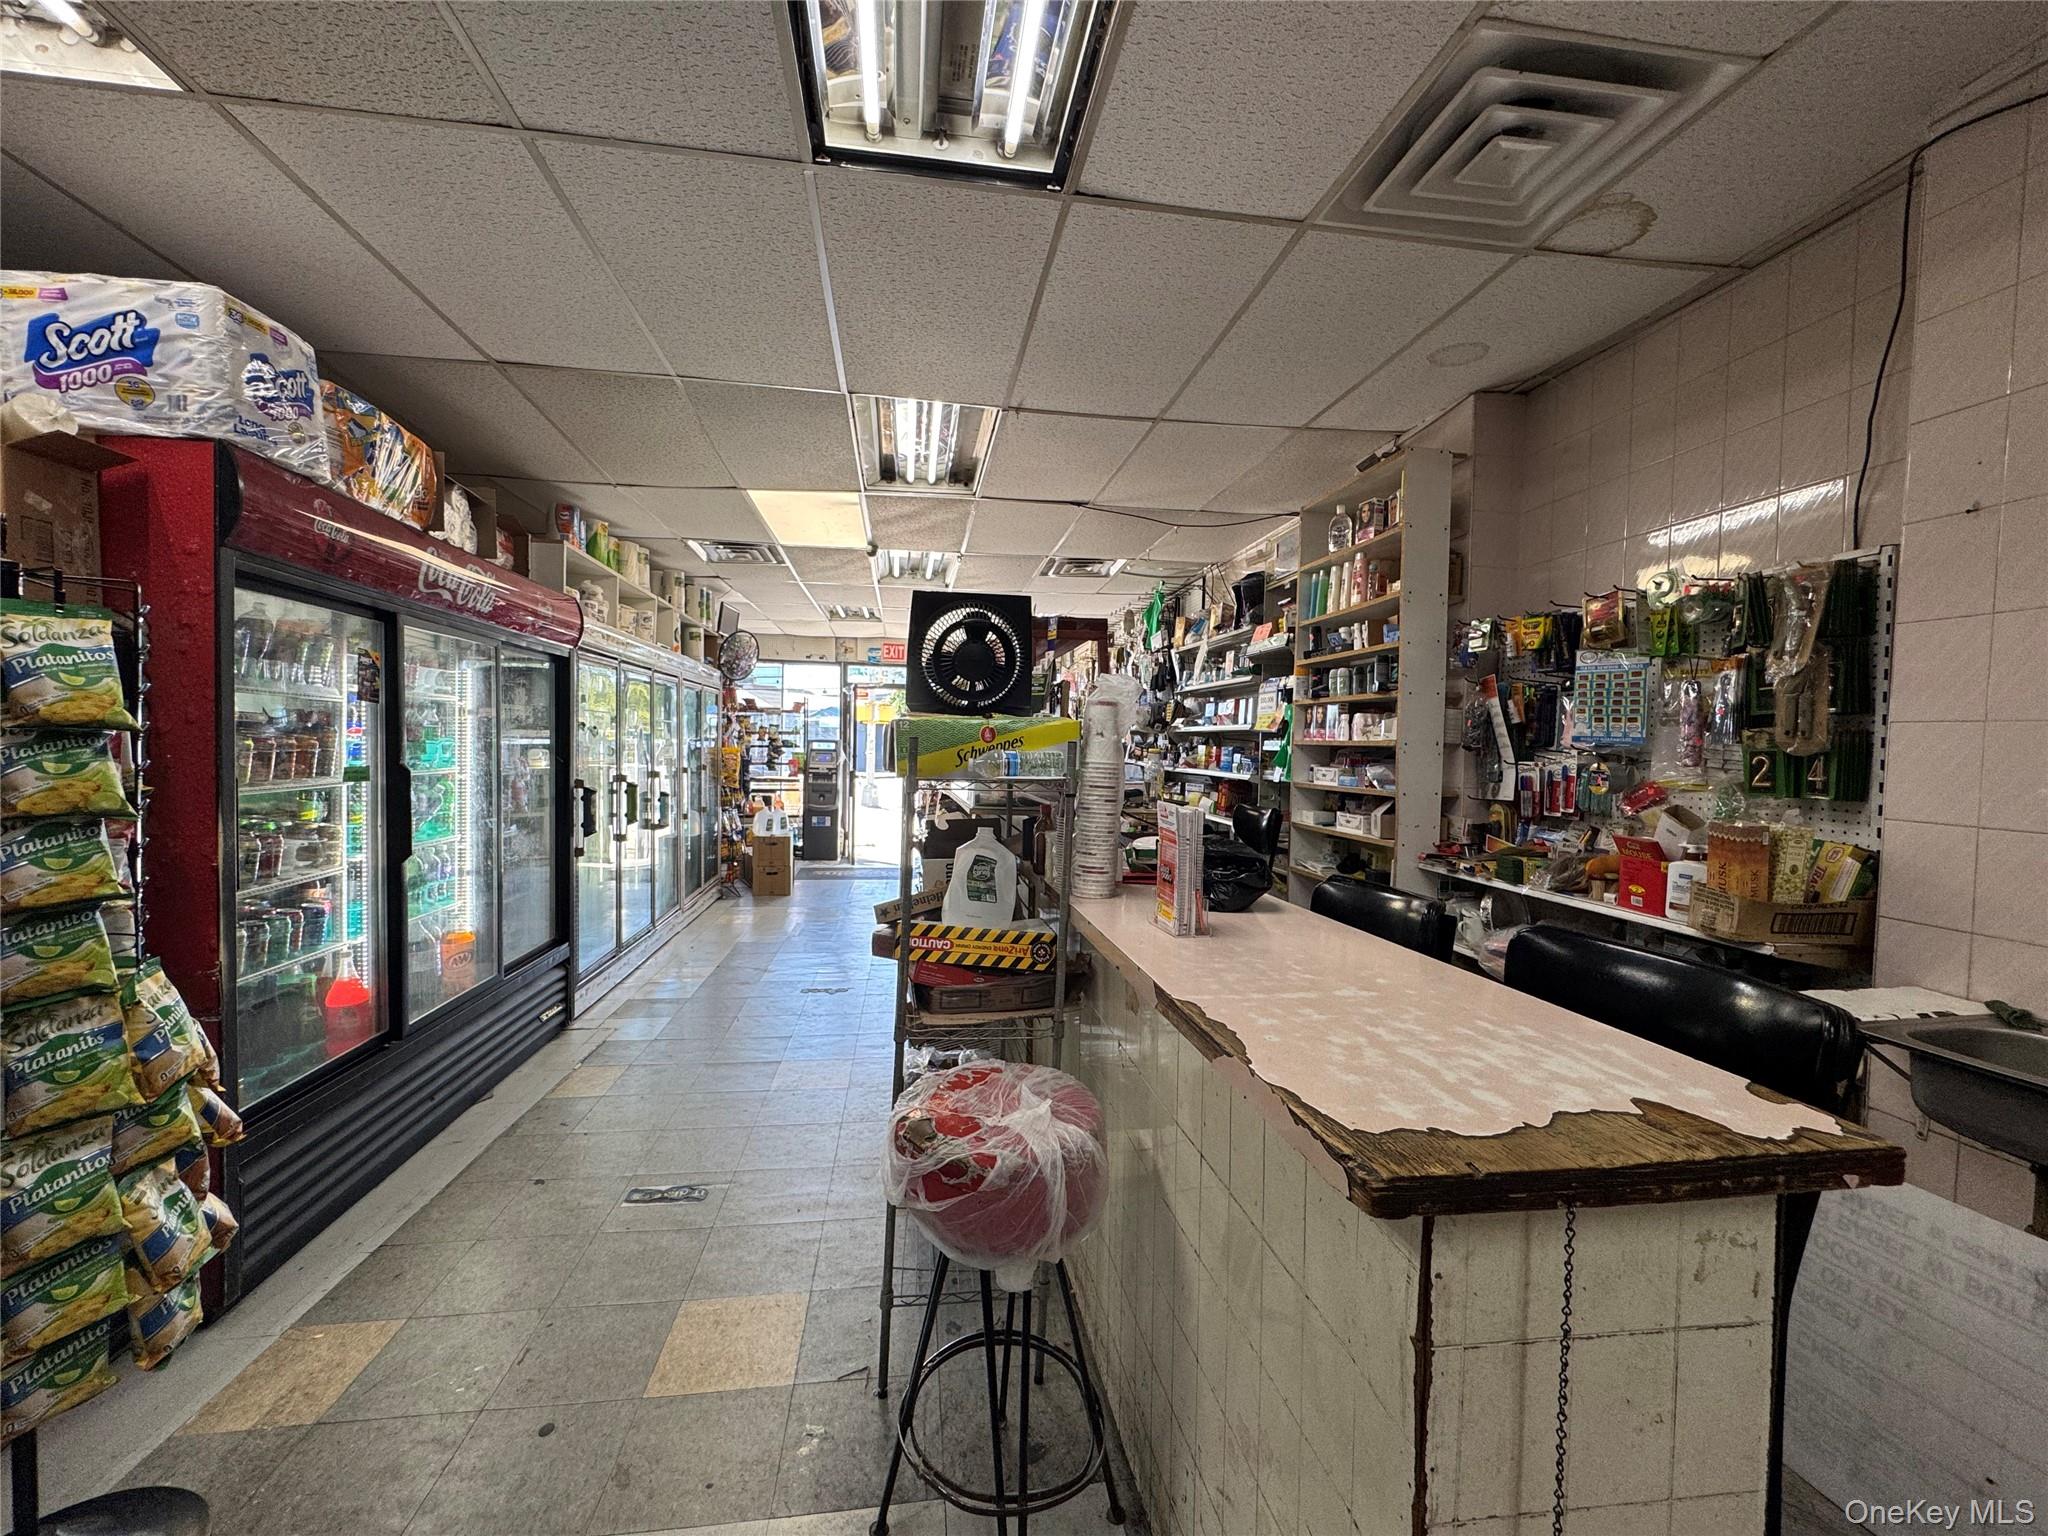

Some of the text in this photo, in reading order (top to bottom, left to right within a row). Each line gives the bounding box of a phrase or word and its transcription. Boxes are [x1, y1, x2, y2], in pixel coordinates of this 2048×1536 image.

[39, 311, 140, 368] Scott
[59, 365, 112, 393] 1000
[1, 618, 108, 649] Soldanza
[11, 646, 114, 675] Platanitos
[883, 644, 905, 659] EXIT
[898, 720, 911, 730] 12
[955, 735, 1025, 768] Schweppes
[1751, 755, 1772, 788] 2
[1807, 755, 1828, 790] 4
[0, 825, 100, 862] Platanito
[1750, 869, 1760, 899] MUSK
[0, 909, 97, 948] latanito
[910, 936, 951, 950] CAUTIO
[992, 945, 1030, 957] AriZona
[0, 1124, 106, 1188] Soldanza
[9, 1152, 115, 1214] Platanitos
[5, 1240, 113, 1306] Platanitos
